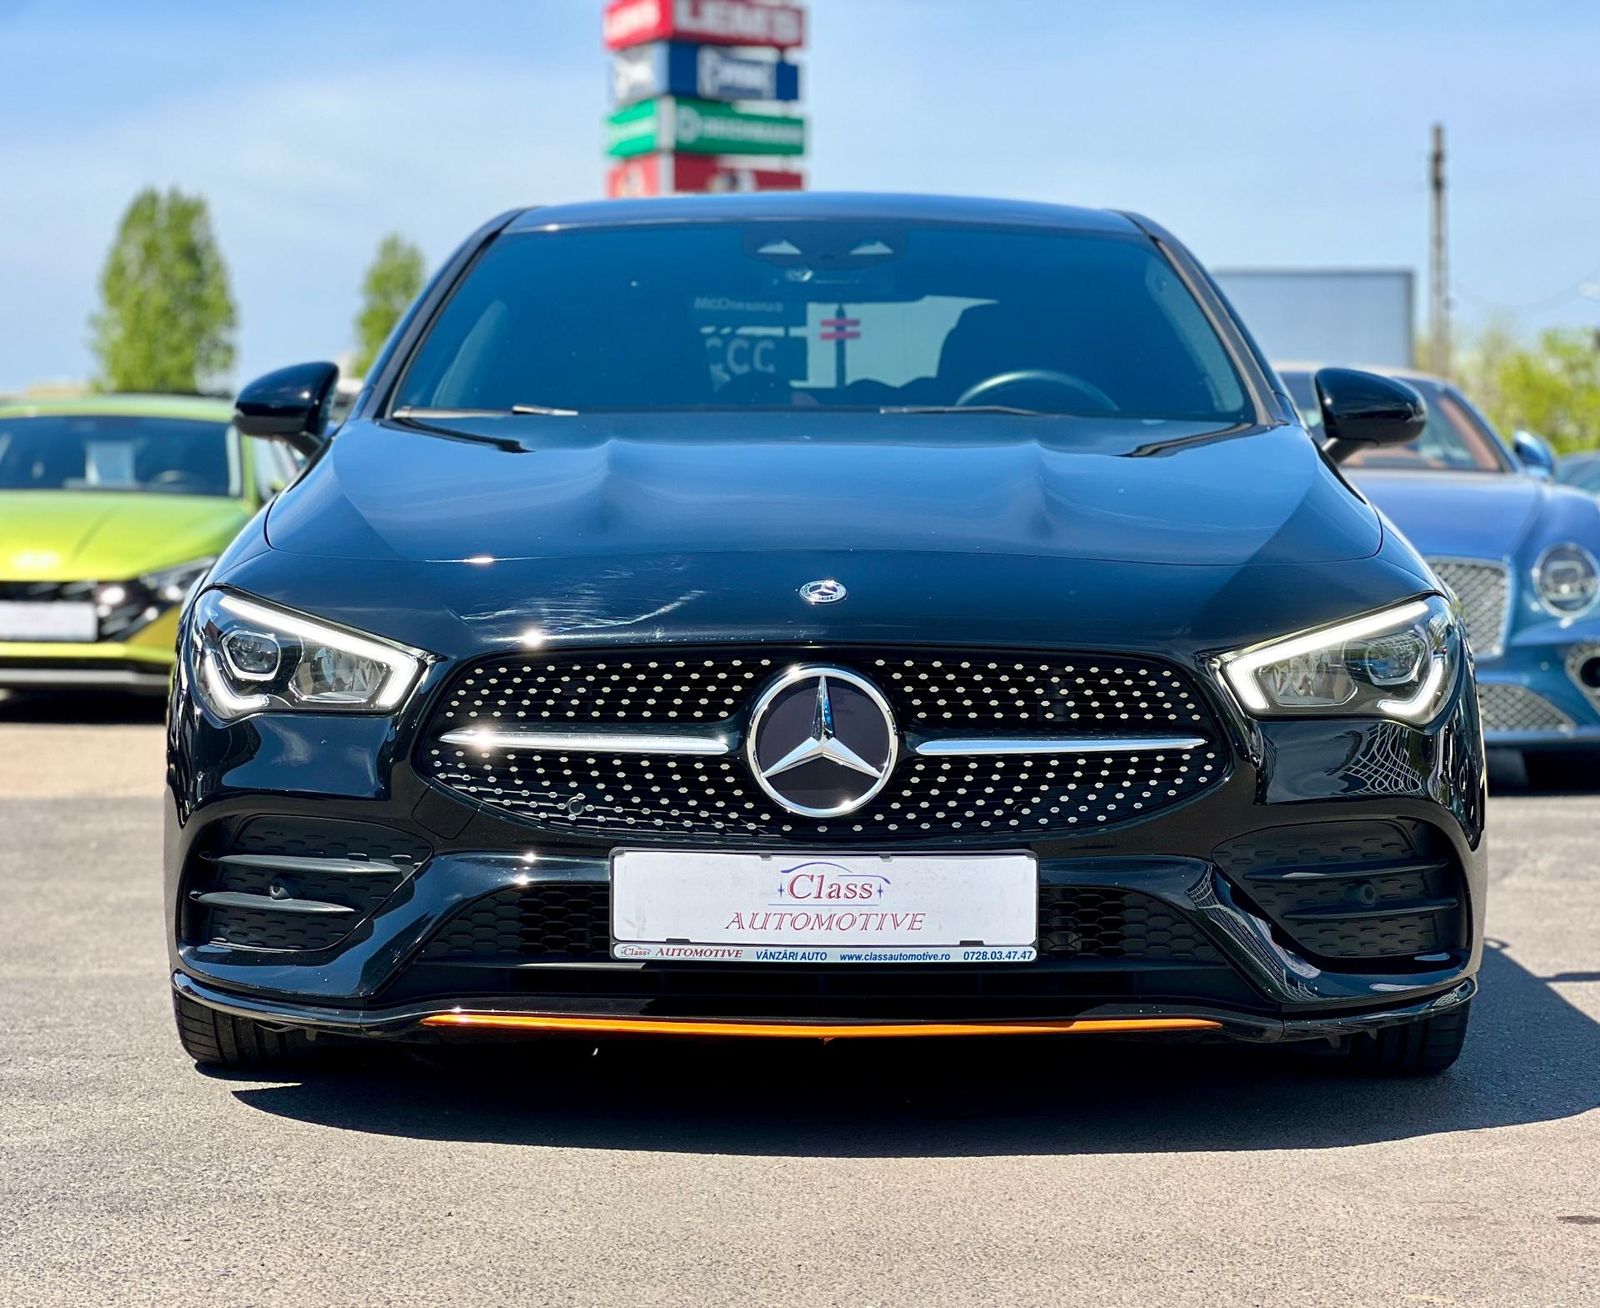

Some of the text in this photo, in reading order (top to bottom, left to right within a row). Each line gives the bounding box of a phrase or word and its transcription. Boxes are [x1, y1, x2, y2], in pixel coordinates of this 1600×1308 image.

[788, 872, 874, 900] Class
[724, 911, 926, 933] AUTOMOTIVE
[655, 948, 743, 959] AUTOMOTIVE
[800, 951, 828, 961] AUTO
[839, 952, 951, 962] www.classautomotive.ro
[963, 950, 1033, 961] 0728.03.47.47
